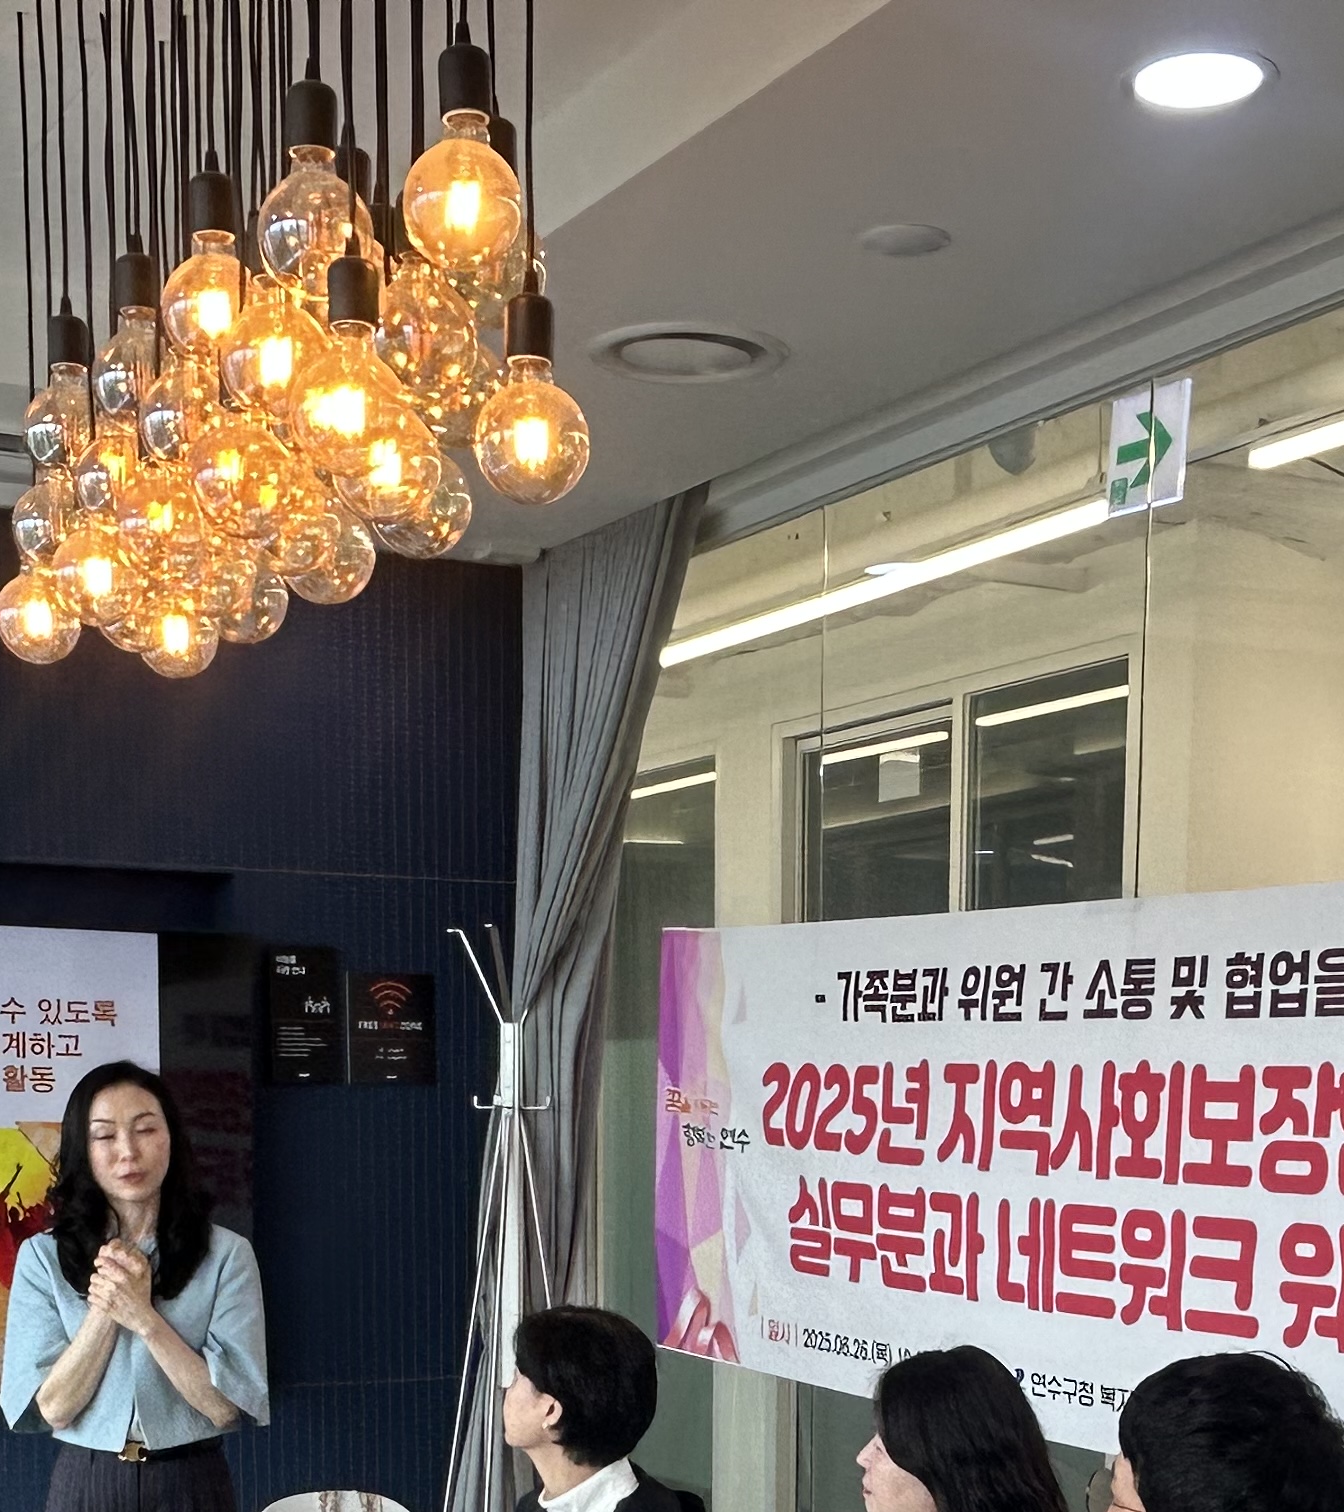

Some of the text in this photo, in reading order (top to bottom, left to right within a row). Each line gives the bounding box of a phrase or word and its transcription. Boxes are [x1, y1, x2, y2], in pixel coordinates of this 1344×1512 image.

[837, 967, 948, 1023] 가족분과
[958, 963, 1026, 1022] 위원
[1038, 961, 1074, 1021] 간
[1083, 958, 1156, 1020] 소통
[1170, 954, 1209, 1020] 및
[0, 997, 27, 1024] 수
[38, 998, 118, 1026] 있도록
[2, 1064, 56, 1093] 활동
[762, 1058, 930, 1167] 2025년
[720, 1127, 750, 1153] 연수
[788, 1175, 985, 1302] 실무분과
[997, 1197, 1259, 1339] 네트워크
[1031, 1372, 1095, 1407] 연수구청
